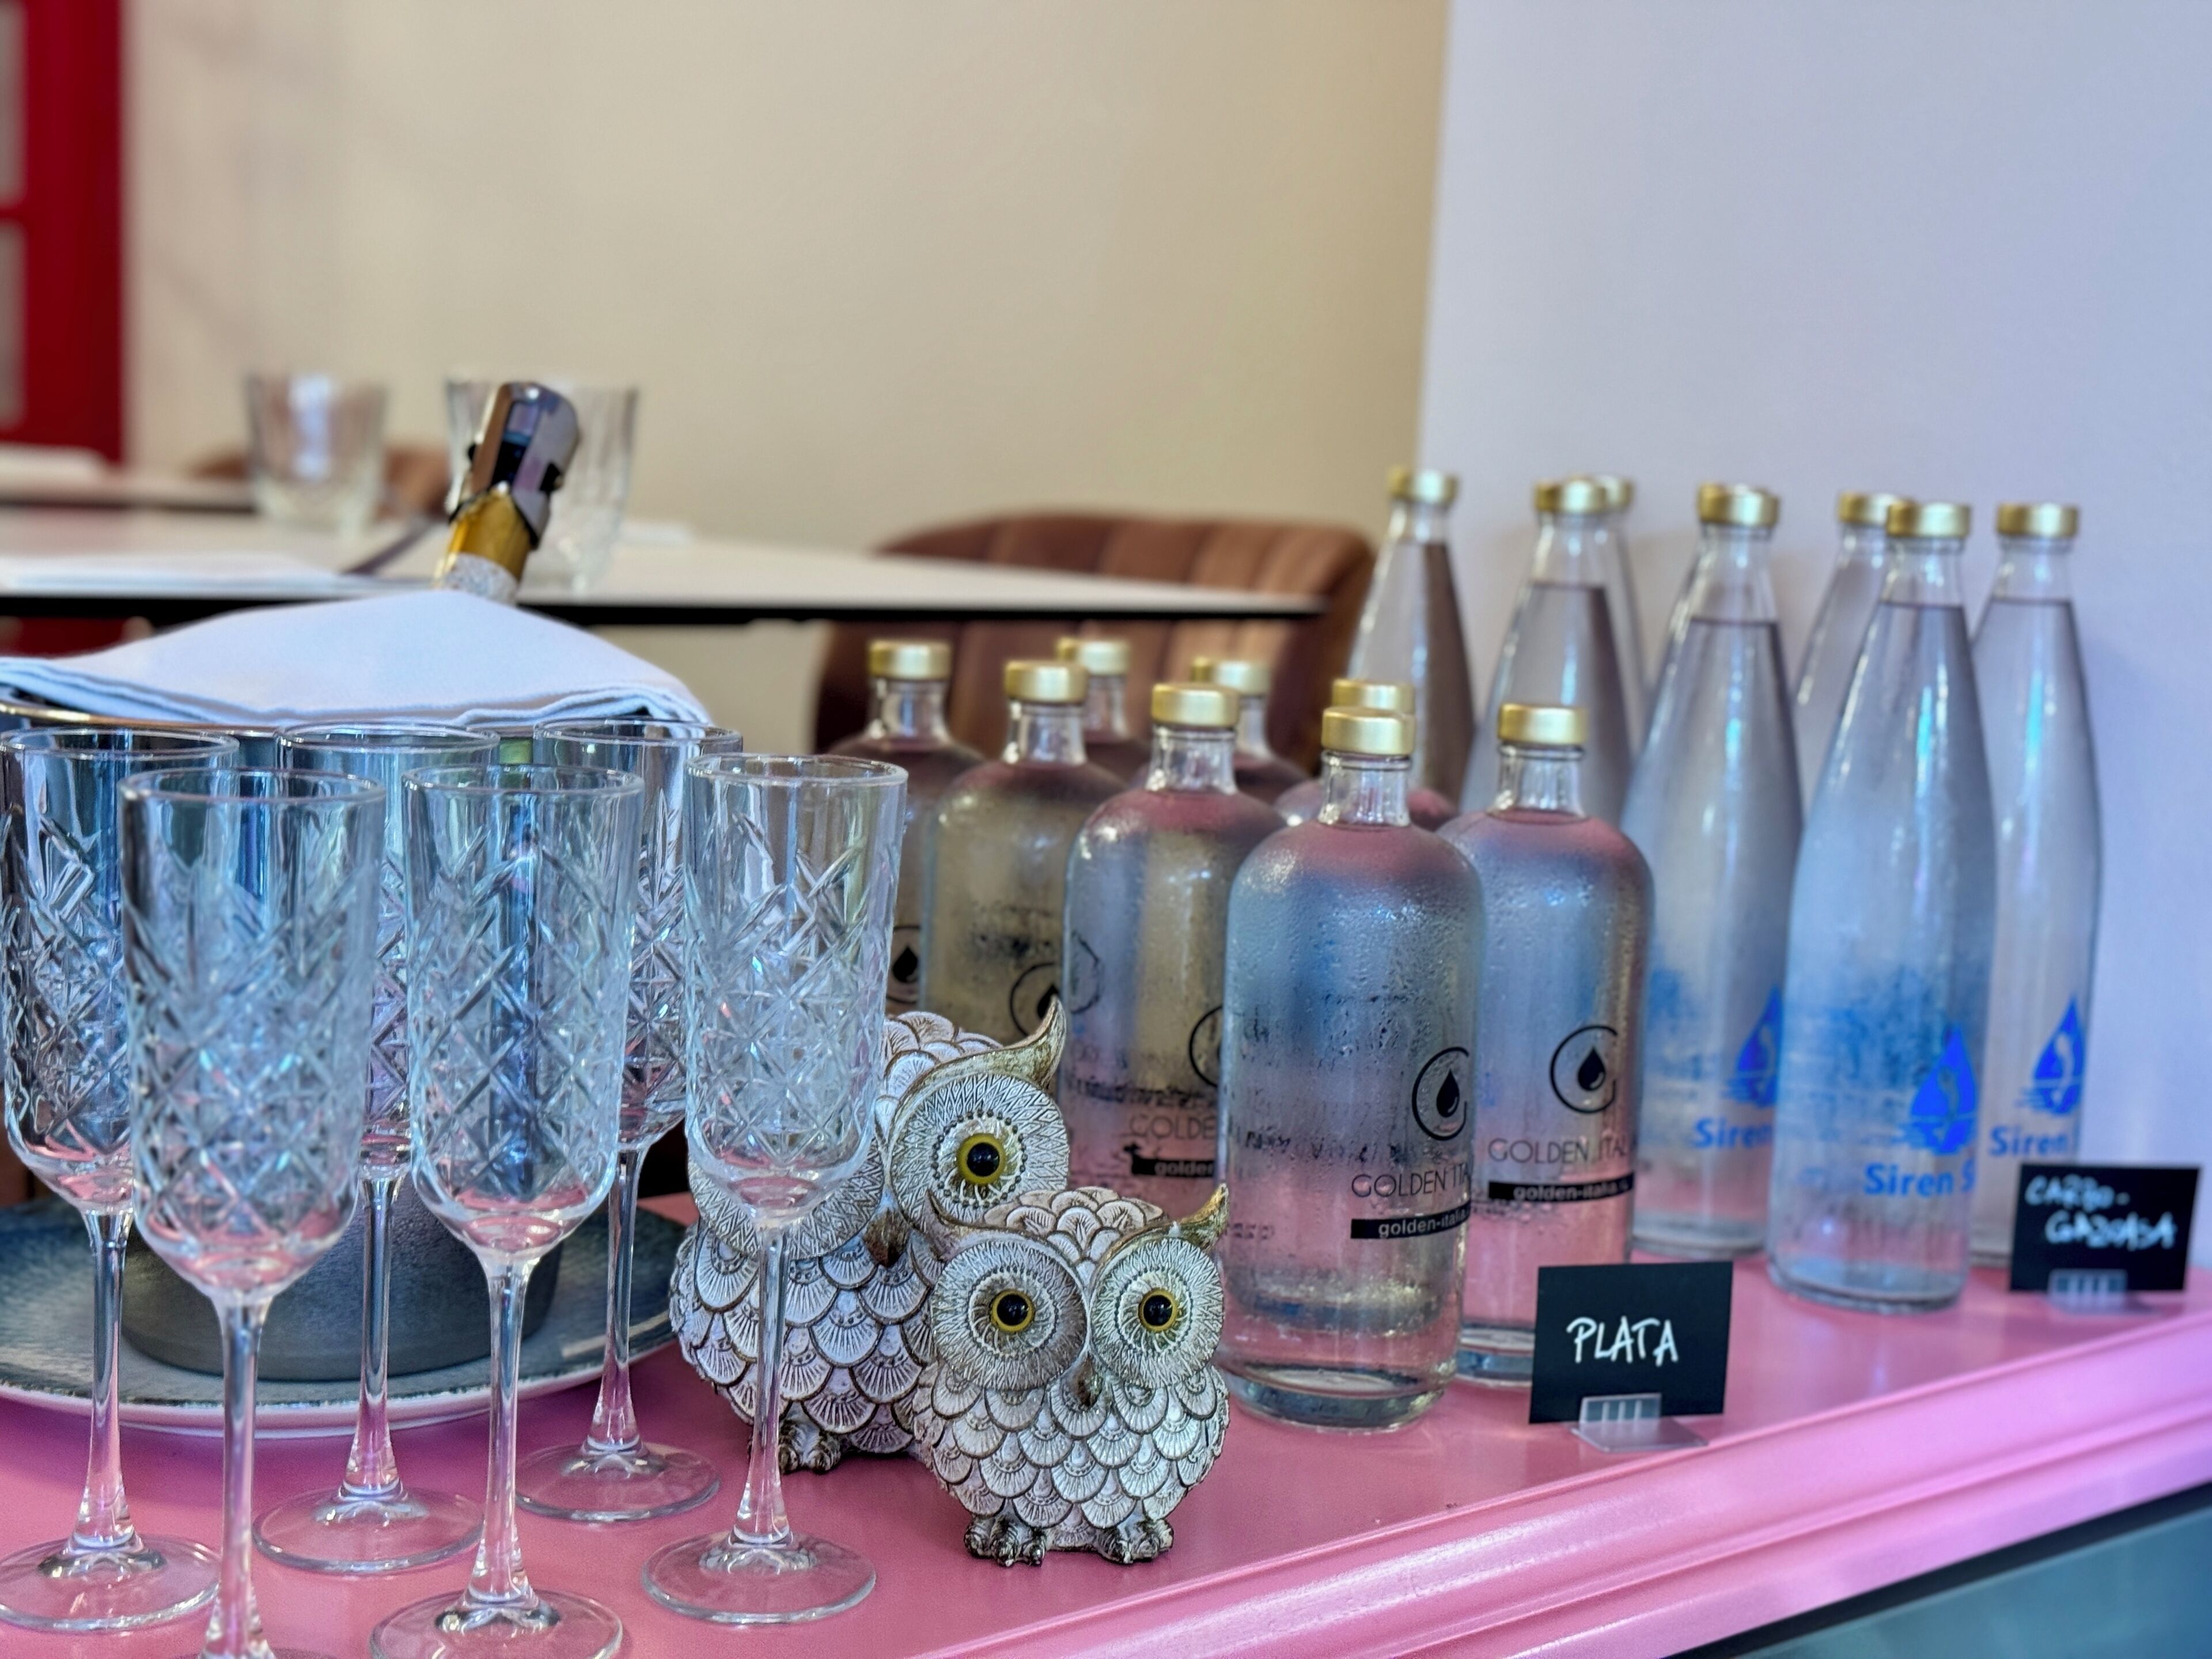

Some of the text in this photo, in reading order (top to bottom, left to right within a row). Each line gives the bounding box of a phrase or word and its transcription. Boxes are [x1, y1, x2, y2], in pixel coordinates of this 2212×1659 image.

[1488, 1138, 1588, 1164] GOLDEN
[1990, 1125, 2069, 1156] Siren
[1351, 1167, 1447, 1198] GOLDEN
[1863, 1162, 1954, 1197] Siren
[1566, 1316, 1679, 1368] PLATA
